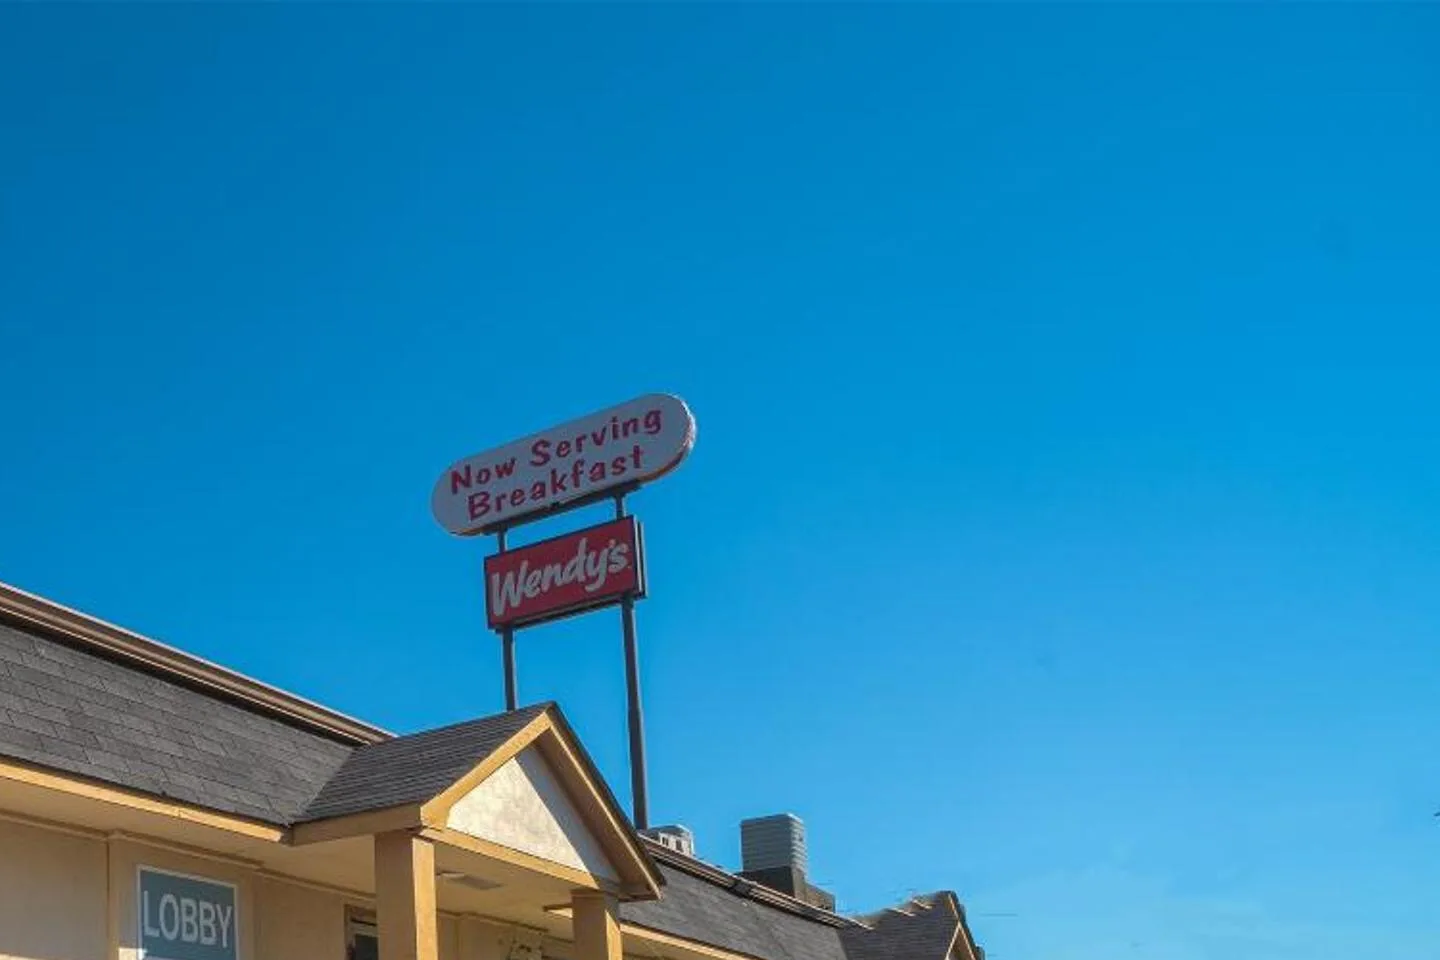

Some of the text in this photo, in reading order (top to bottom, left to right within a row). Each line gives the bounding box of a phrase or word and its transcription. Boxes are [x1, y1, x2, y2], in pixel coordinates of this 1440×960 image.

[451, 409, 663, 494] Now Serving
[468, 444, 644, 521] Breakfast
[492, 537, 629, 616] Wendy's
[143, 890, 233, 949] LOBBY
